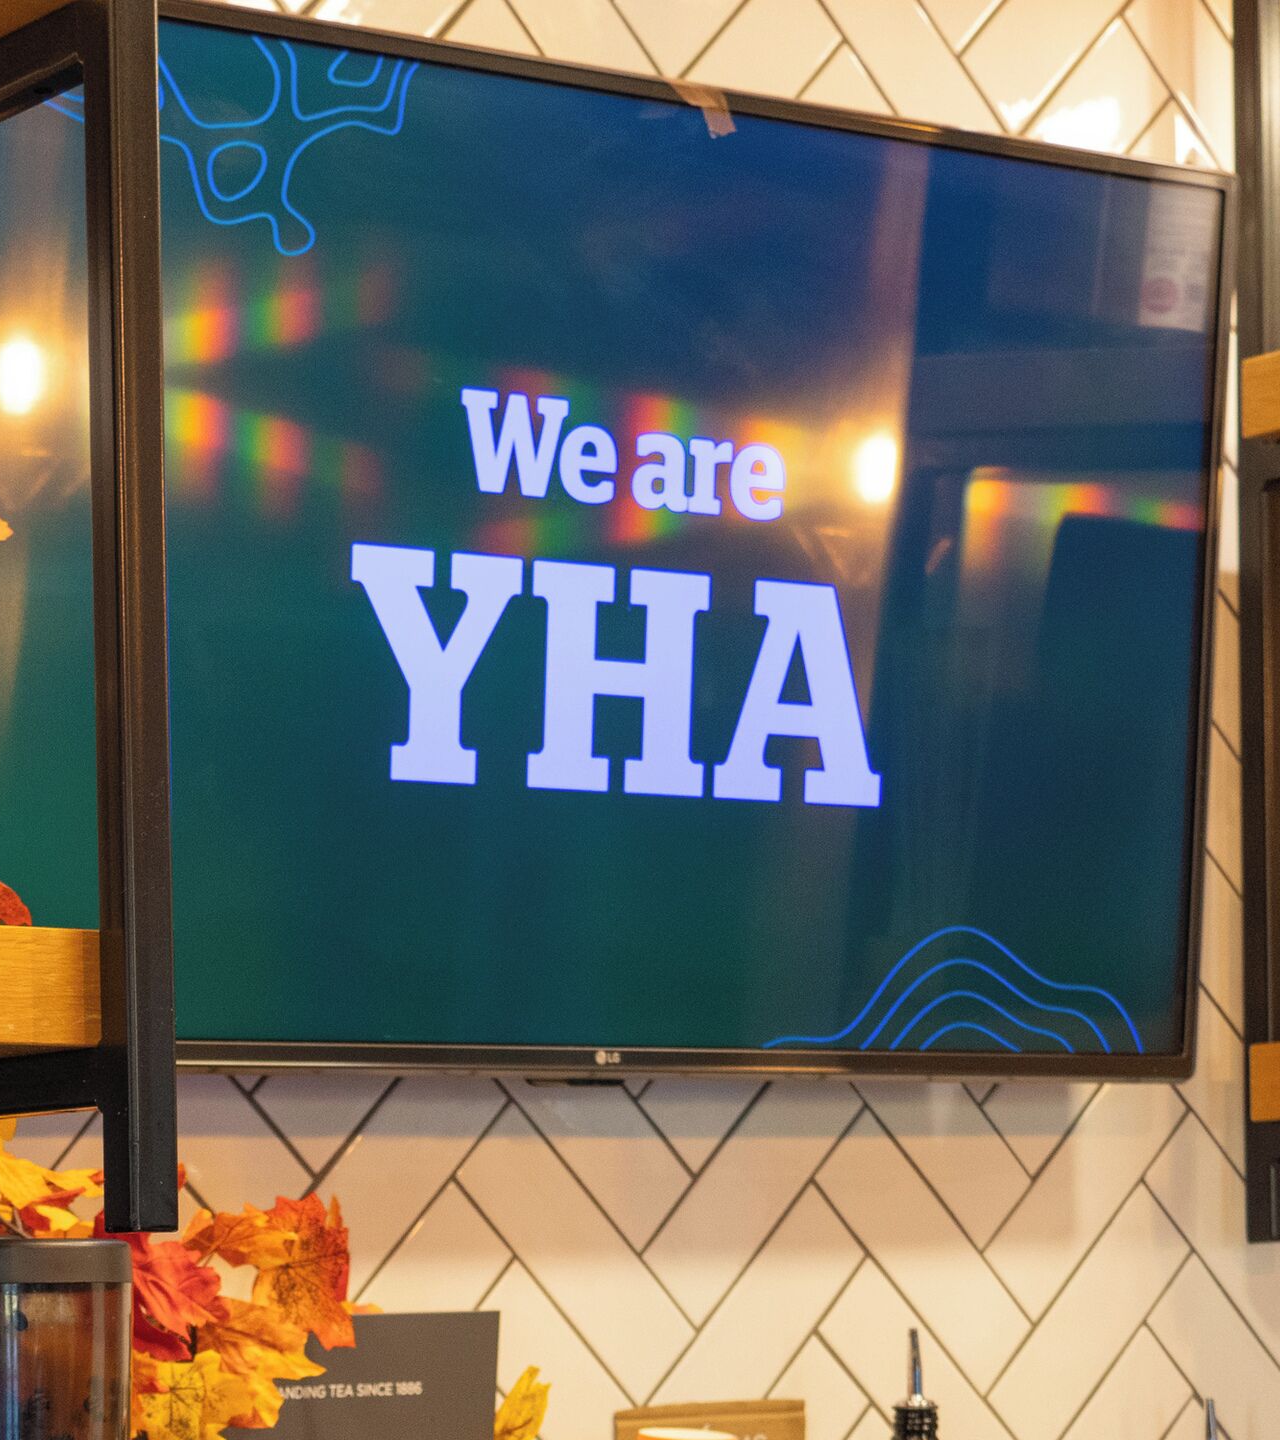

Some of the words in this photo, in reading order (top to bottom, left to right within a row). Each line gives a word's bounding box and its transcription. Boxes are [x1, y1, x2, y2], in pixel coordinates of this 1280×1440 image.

[461, 387, 619, 506] We
[631, 431, 786, 522] are
[351, 541, 882, 808] YHA
[607, 1052, 621, 1064] LG
[328, 1382, 354, 1399] TEA
[356, 1381, 394, 1397] SINCE
